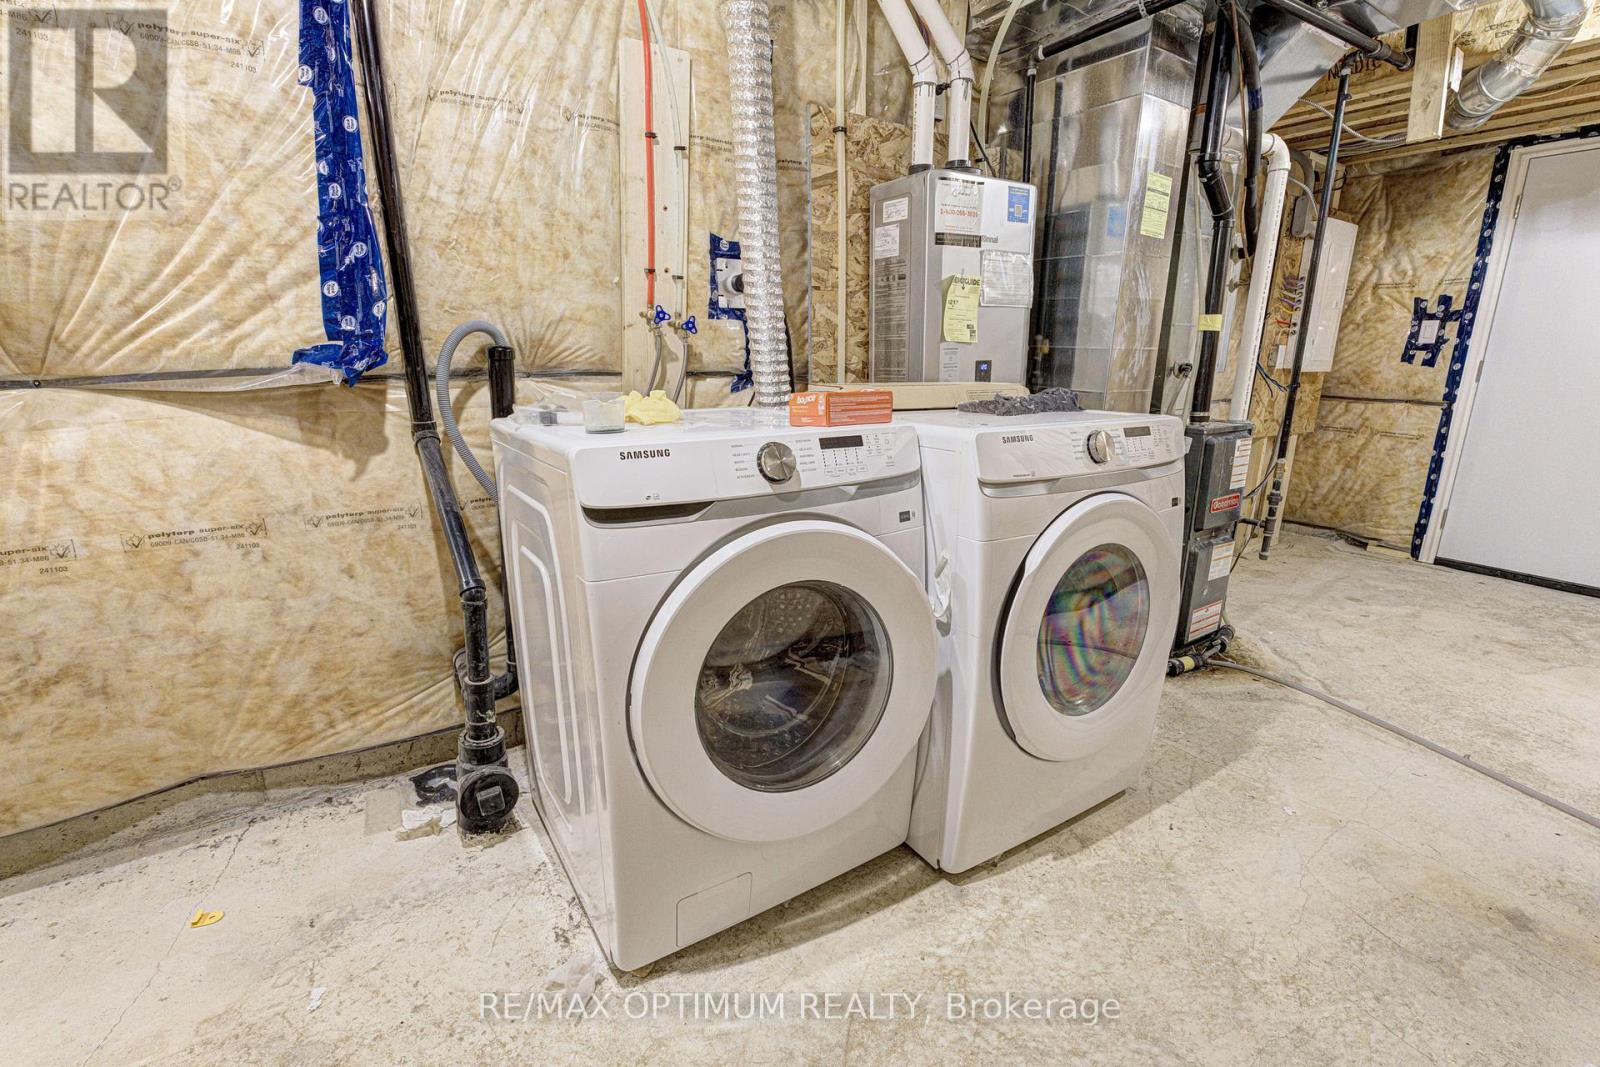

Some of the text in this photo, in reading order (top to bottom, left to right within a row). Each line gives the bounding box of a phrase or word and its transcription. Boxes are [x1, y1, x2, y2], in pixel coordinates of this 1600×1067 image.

[1002, 434, 1034, 444] SAMSUNG
[619, 449, 670, 460] SAMSUNG
[39, 566, 69, 575] 241103
